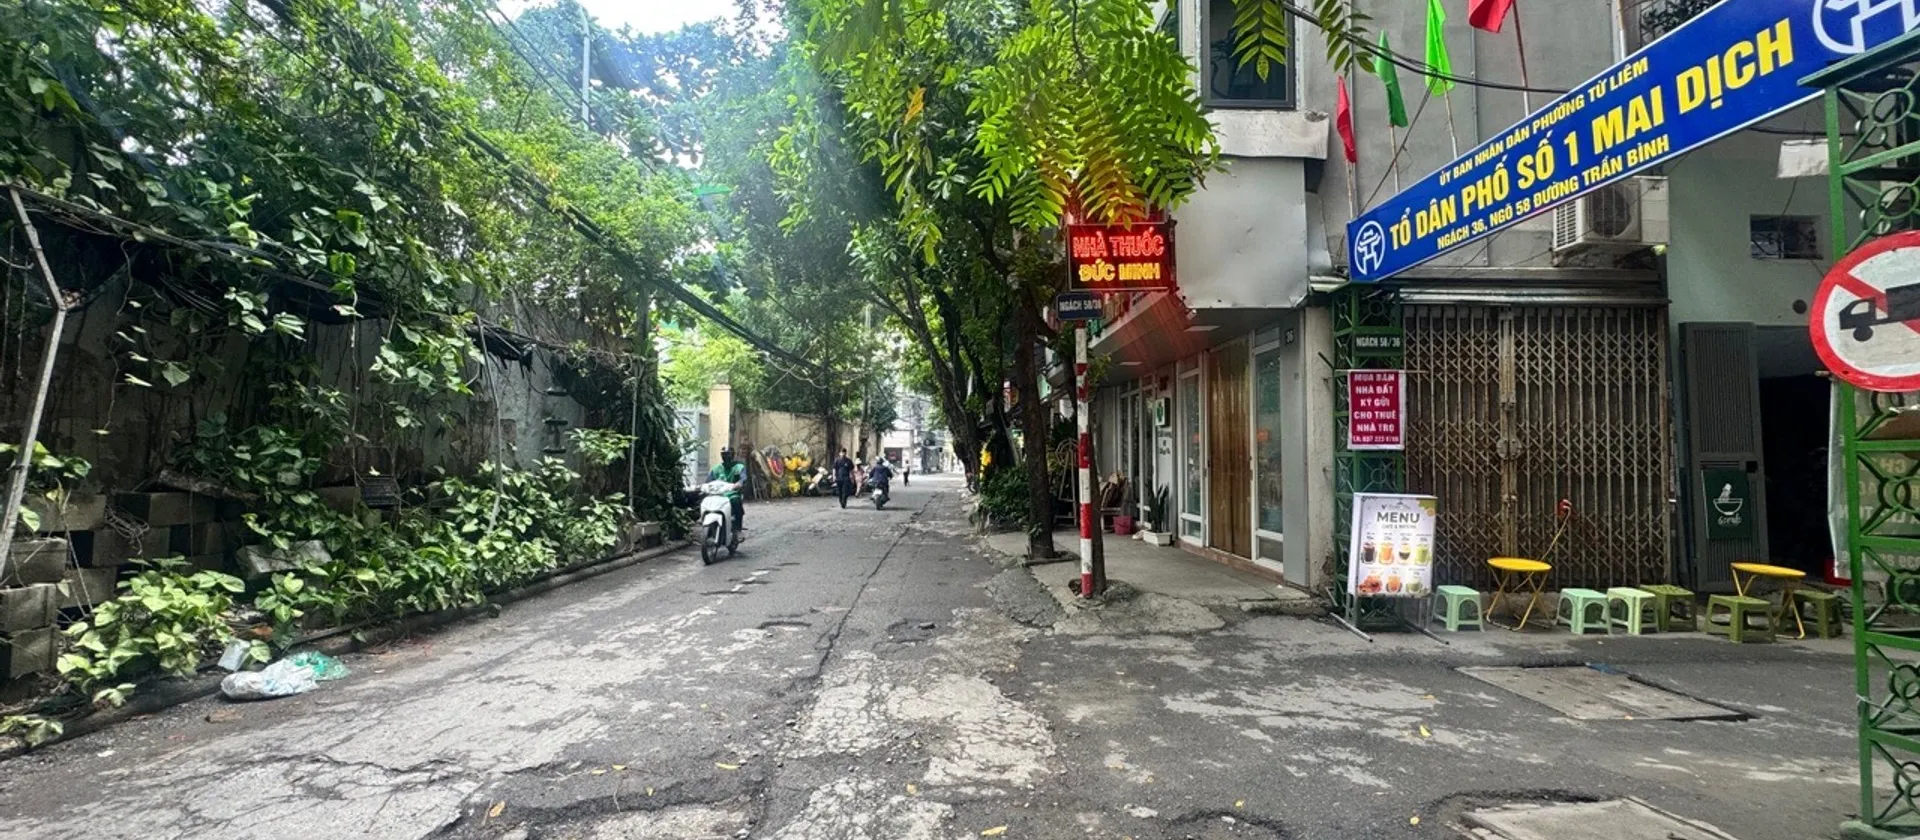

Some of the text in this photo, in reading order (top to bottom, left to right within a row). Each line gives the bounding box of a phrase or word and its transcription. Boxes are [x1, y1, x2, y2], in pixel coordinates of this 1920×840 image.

[1440, 56, 1649, 185] ỦY BAN NHÂN DÂN PHƯỜNG TỪ LIÊM
[1390, 18, 1794, 250] TỔ DÂN PHỐ SỐ 1 MAI DỊCH
[1437, 134, 1670, 250] NGÁCH 36, NGÕ 58 ĐƯỜNG TRẦN BÌNH
[1072, 226, 1165, 258] NHÀ THUỐC
[1078, 258, 1161, 281] ĐỨC MINH
[1059, 299, 1083, 312] NGÁCH
[1356, 335, 1378, 347] NGÁCH
[1355, 382, 1393, 394] NHÀ ĐẤT
[1353, 409, 1397, 420] CHO THUÊ
[1356, 422, 1376, 432] NHÀ
[1377, 511, 1421, 524] MENU
